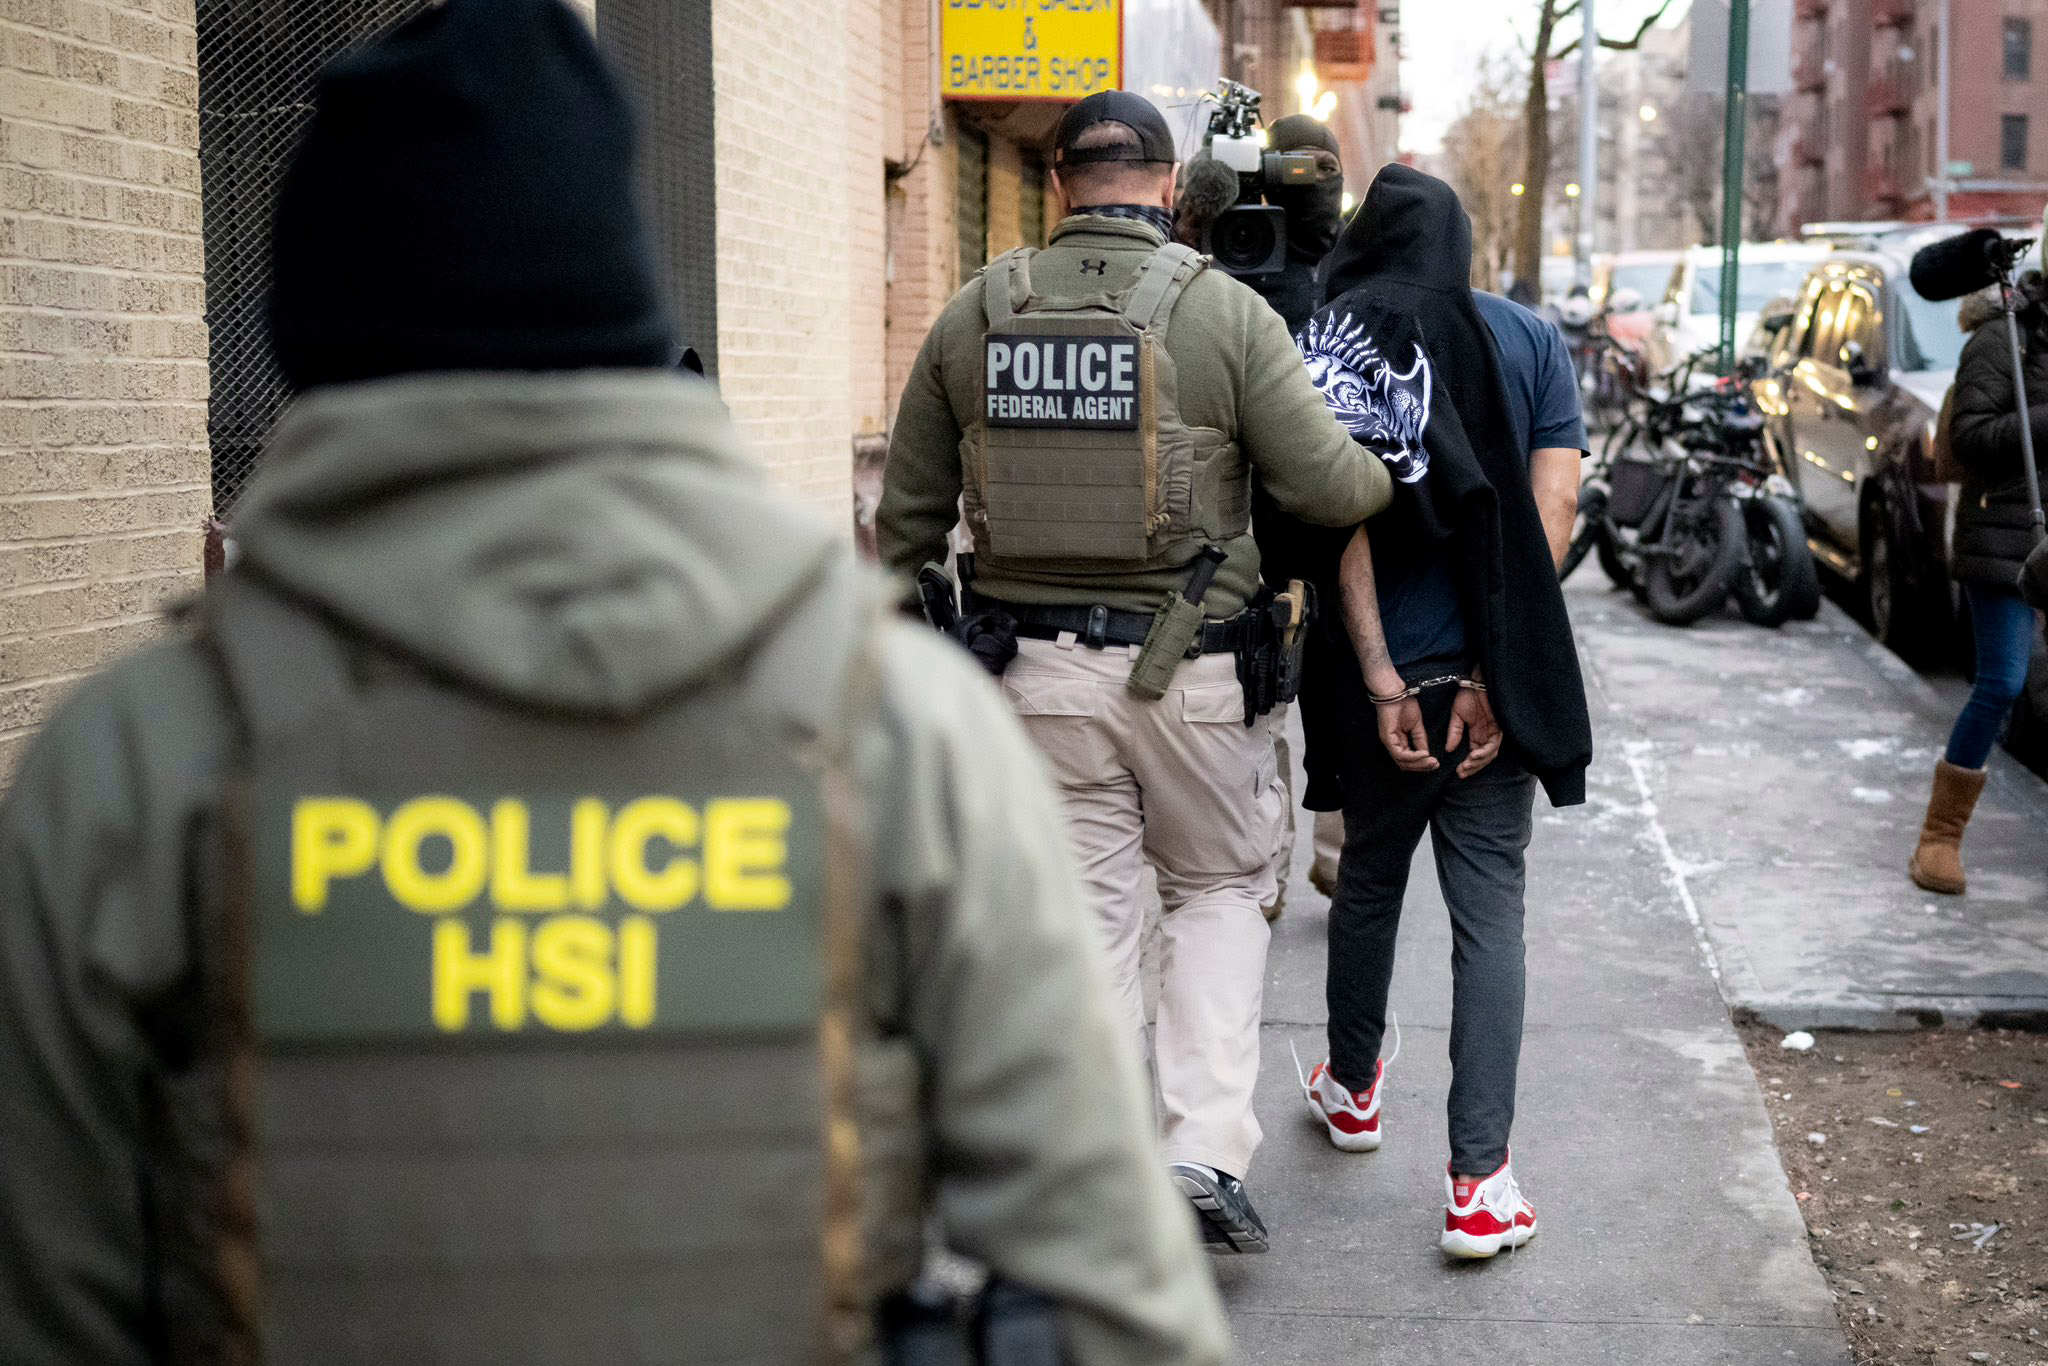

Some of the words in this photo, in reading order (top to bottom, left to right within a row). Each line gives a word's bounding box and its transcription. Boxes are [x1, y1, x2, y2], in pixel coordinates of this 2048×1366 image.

[1023, 16, 1037, 49] &
[951, 54, 1040, 88] BARBER
[1050, 57, 1109, 91] SHOP
[987, 342, 1134, 391] POLICE
[987, 394, 1067, 419] FEDERAL
[1072, 396, 1134, 420] AGENT
[291, 796, 793, 914] POLICE
[431, 915, 657, 1033] HSI
